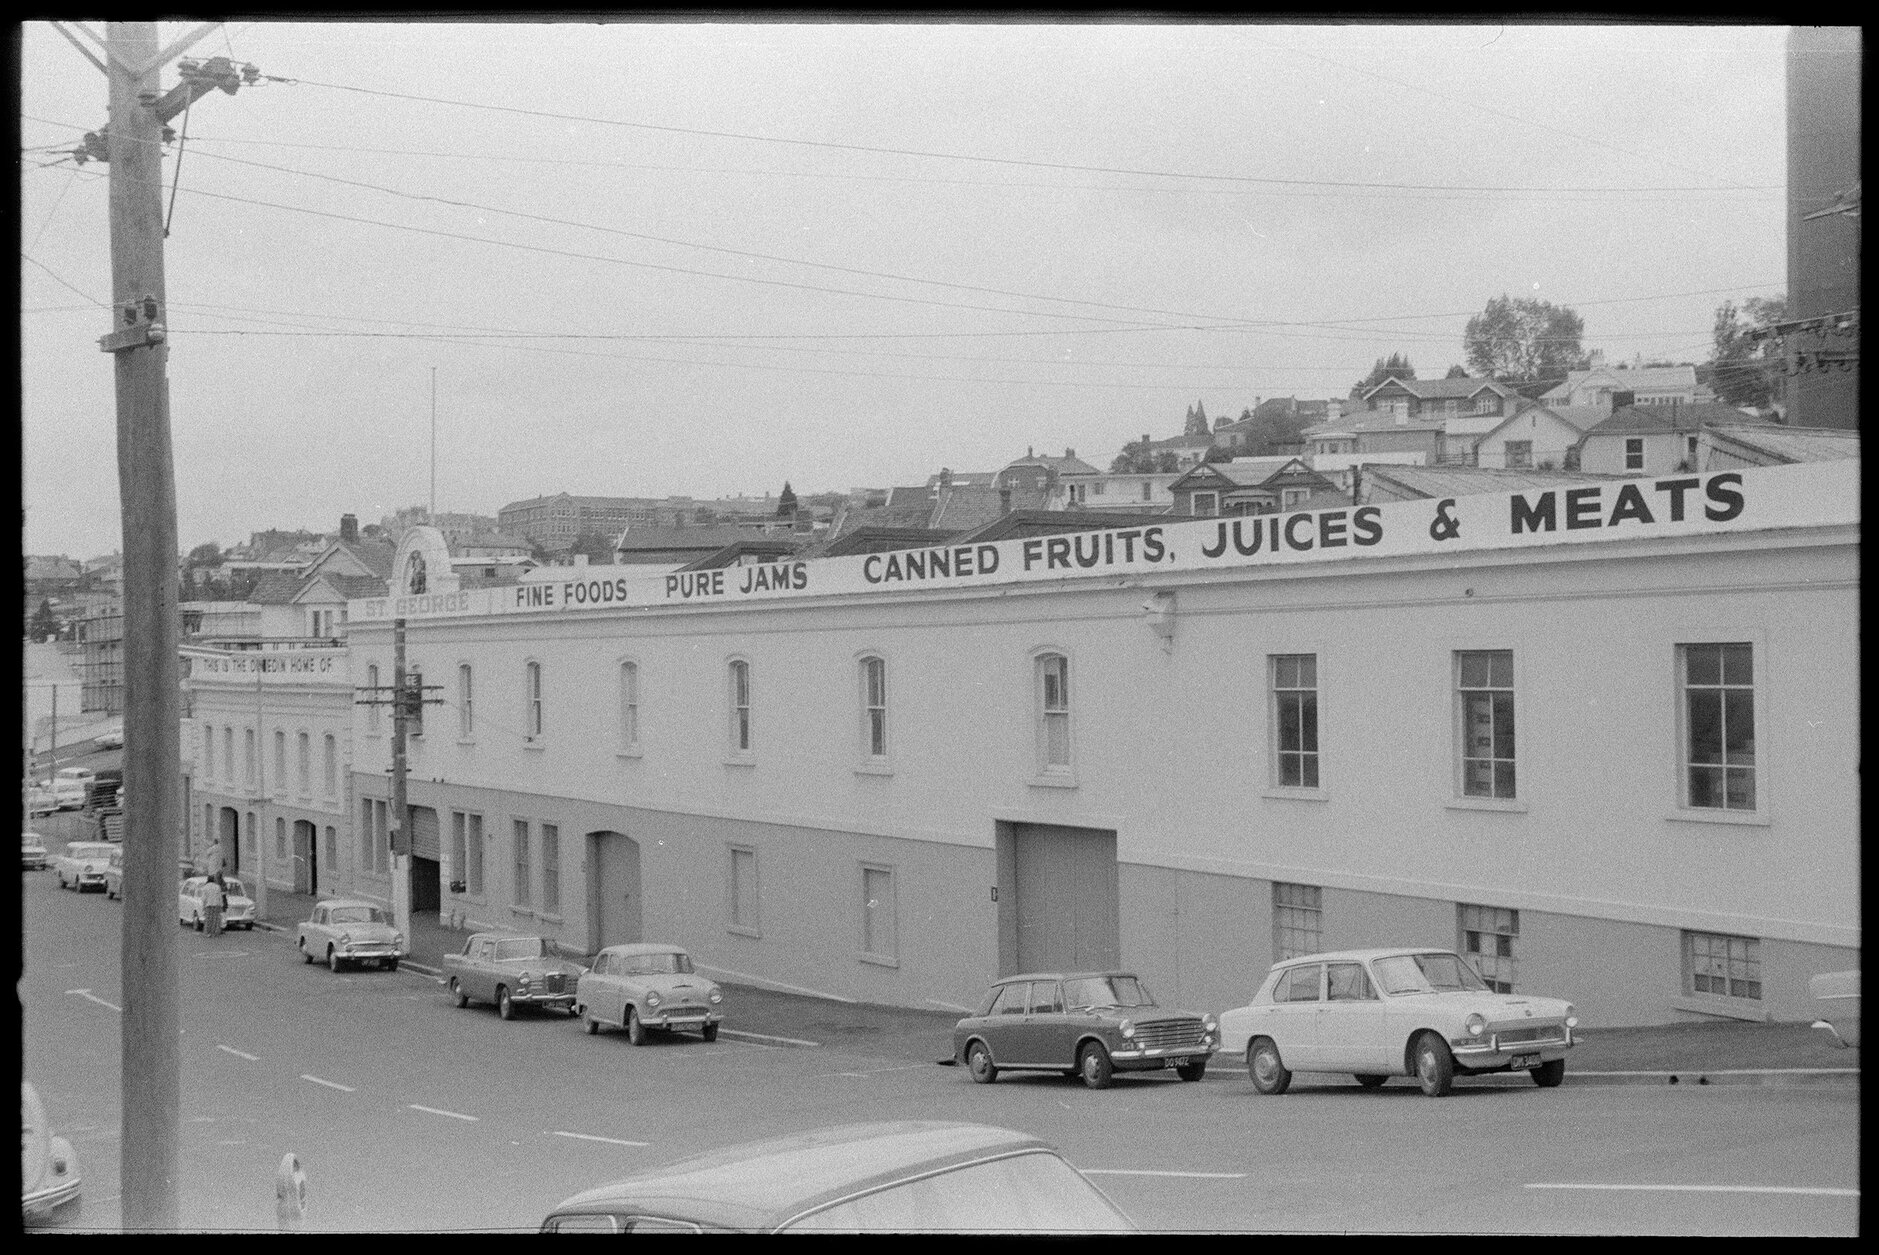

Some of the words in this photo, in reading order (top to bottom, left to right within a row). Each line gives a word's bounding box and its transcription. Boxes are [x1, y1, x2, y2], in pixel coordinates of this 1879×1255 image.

[396, 592, 469, 615] GEORGE
[516, 585, 554, 607] FINE
[564, 578, 628, 605] FOODS
[665, 570, 724, 599] PURE
[739, 561, 808, 594] JAMS
[863, 544, 1000, 584] CANNED
[1023, 527, 1176, 571] FRUITS,
[1202, 506, 1383, 559] JUICES
[1429, 498, 1460, 542] &
[1510, 472, 1745, 534] MEATS
[290, 658, 315, 673] HOME
[320, 657, 332, 673] OF
